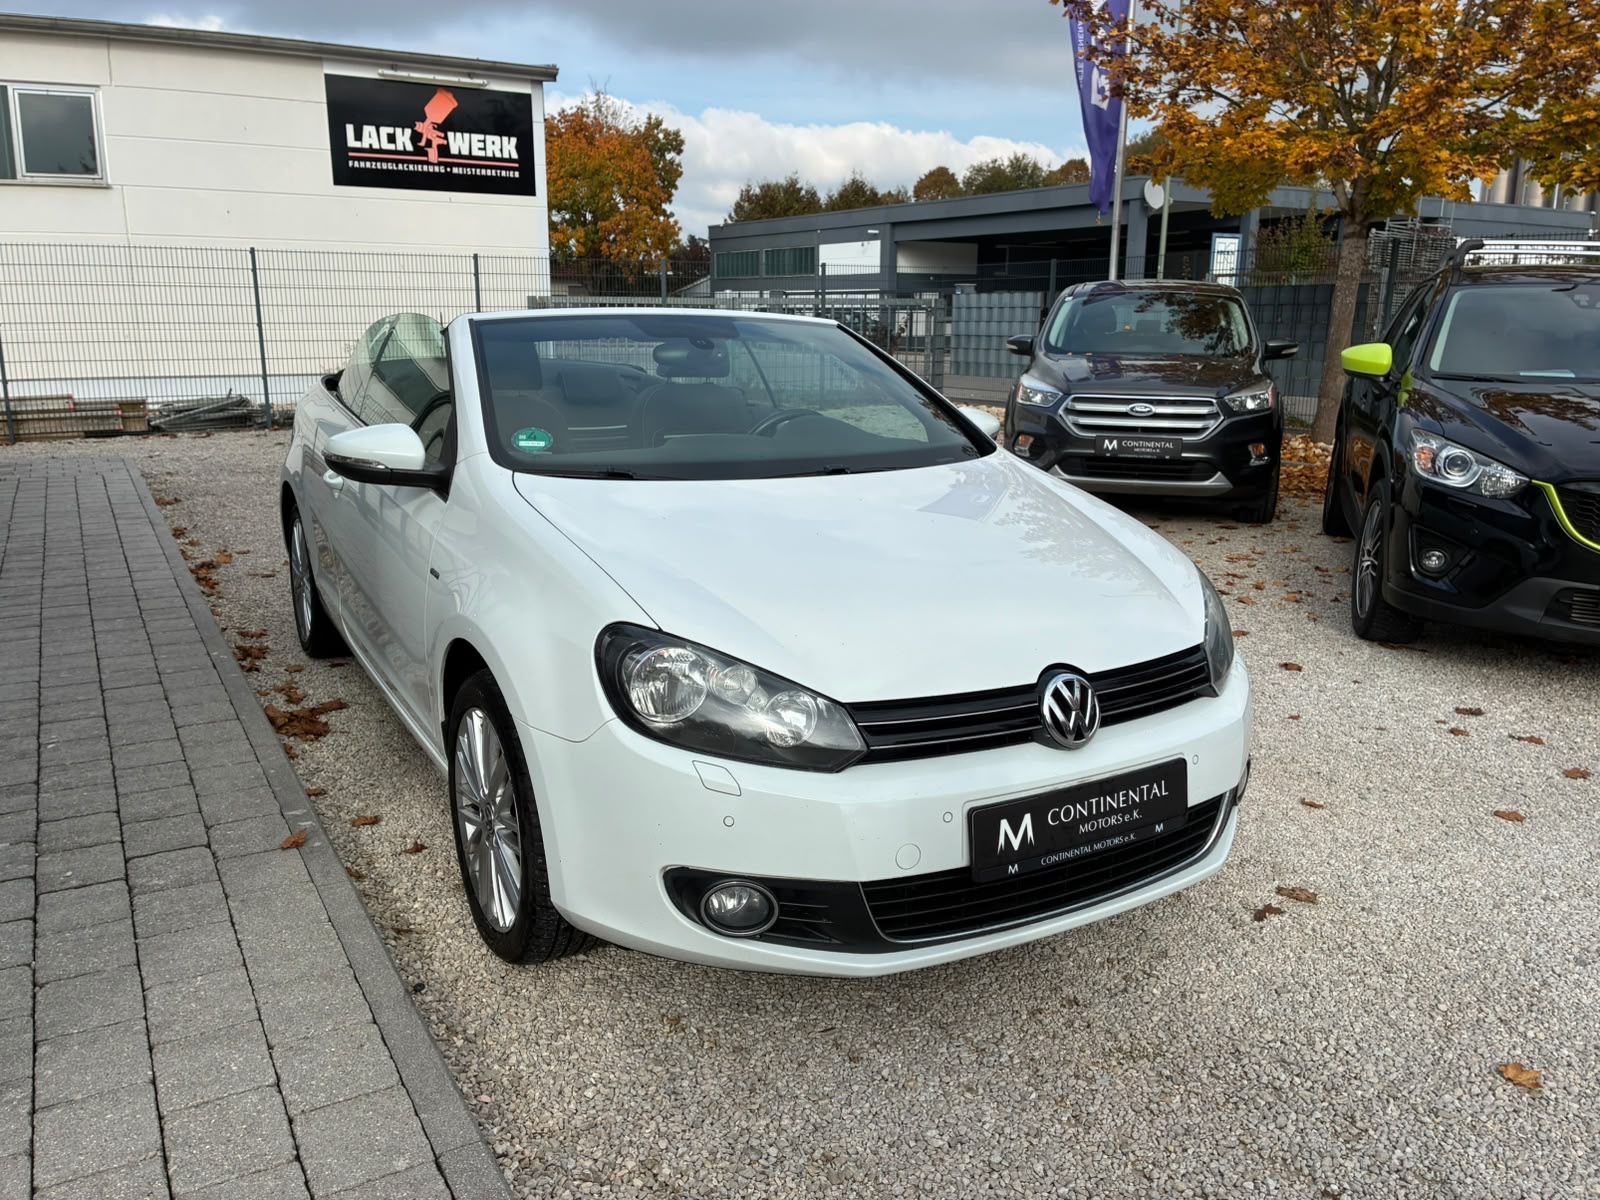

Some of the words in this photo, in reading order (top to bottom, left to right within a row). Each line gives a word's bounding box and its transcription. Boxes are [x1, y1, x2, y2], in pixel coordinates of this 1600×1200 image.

[345, 123, 414, 151] LACK
[447, 131, 519, 159] WERK
[348, 160, 445, 173] FAHRZEUGLACKIERUNG
[452, 166, 520, 178] MEISTERBETRIEB
[1122, 440, 1174, 449] CONTINENTAL
[1047, 780, 1169, 826] CONTINENTAL
[997, 812, 1035, 855] M
[1079, 813, 1123, 835] MOTORS
[1124, 808, 1143, 823] e.K.
[1155, 823, 1164, 833] M
[1041, 845, 1092, 866] CONTINENTAL
[1093, 836, 1124, 851] MOTORS
[1008, 864, 1019, 875] M
